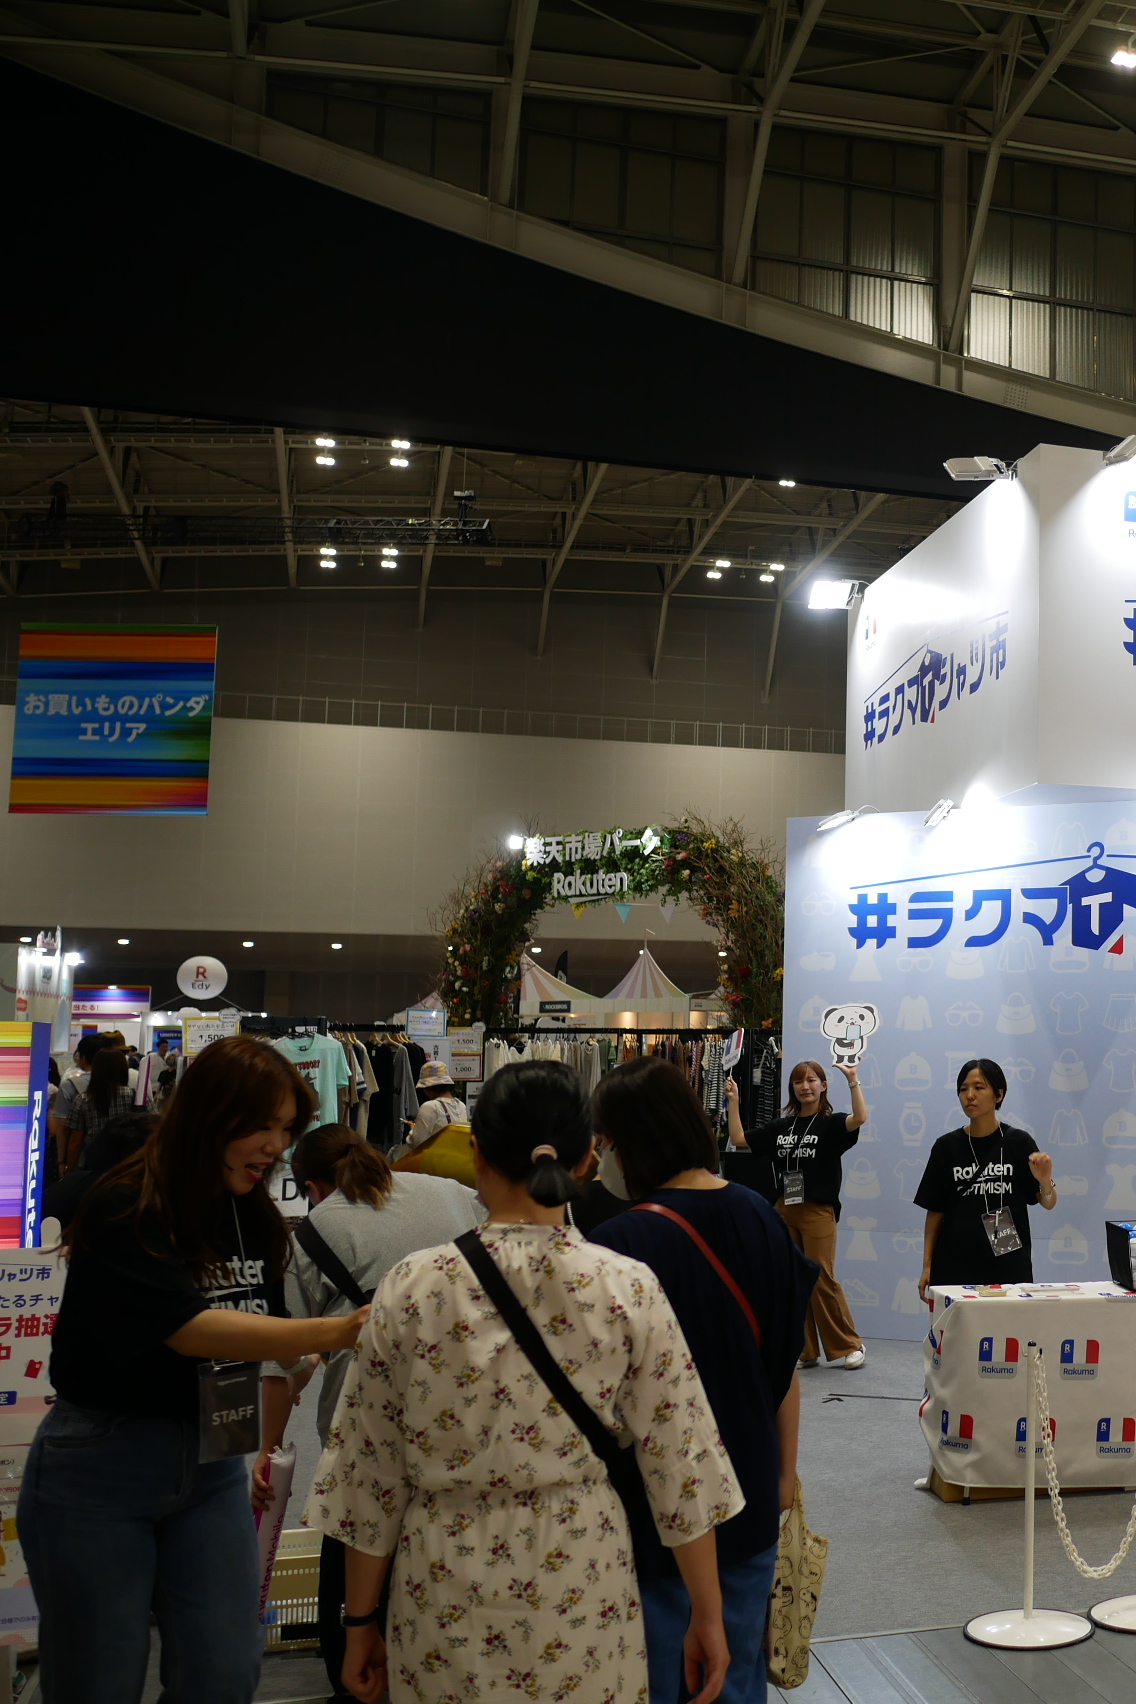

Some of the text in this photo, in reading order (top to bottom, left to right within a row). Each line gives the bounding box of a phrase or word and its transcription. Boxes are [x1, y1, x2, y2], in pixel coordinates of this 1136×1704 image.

[23, 693, 210, 718] お買いものパンダ
[78, 721, 148, 743] エリア
[524, 828, 662, 867] 楽天市場パーク
[553, 868, 628, 898] Rakuten
[191, 982, 211, 991] Edy
[981, 1365, 1014, 1374] Rakuma
[1063, 1367, 1095, 1376] Rakuma
[211, 1404, 255, 1426] STAFF
[1099, 1446, 1131, 1454] Rakuma
[266, 1513, 285, 1562] Mobile
